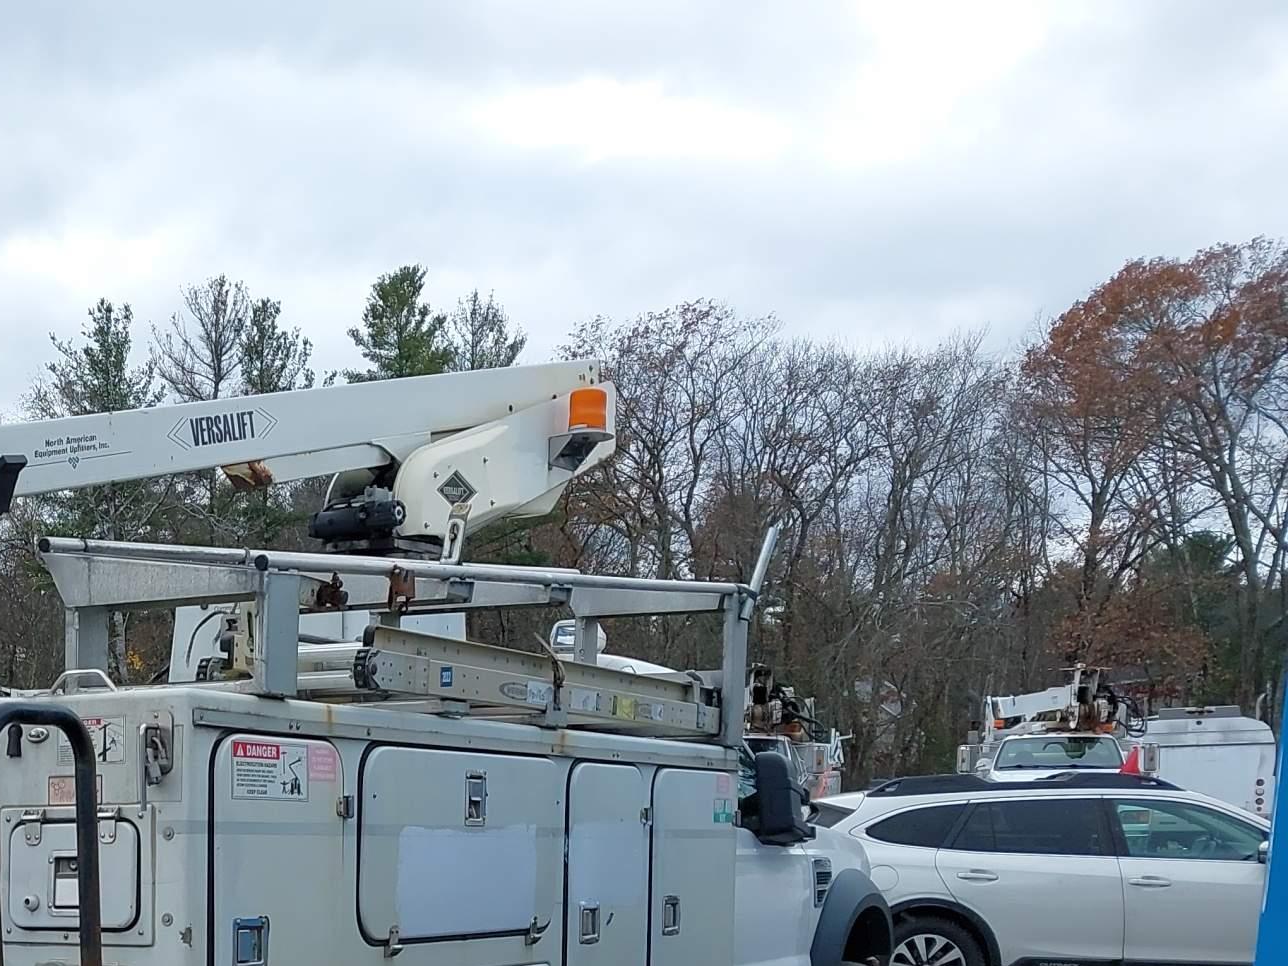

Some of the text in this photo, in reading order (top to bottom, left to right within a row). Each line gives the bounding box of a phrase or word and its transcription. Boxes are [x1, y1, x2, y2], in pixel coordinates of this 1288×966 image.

[190, 411, 255, 446] VERSALIFT
[45, 434, 97, 448] North American
[34, 441, 110, 459] Equipment Upfitters, Inc.
[247, 746, 277, 758] DANGER
